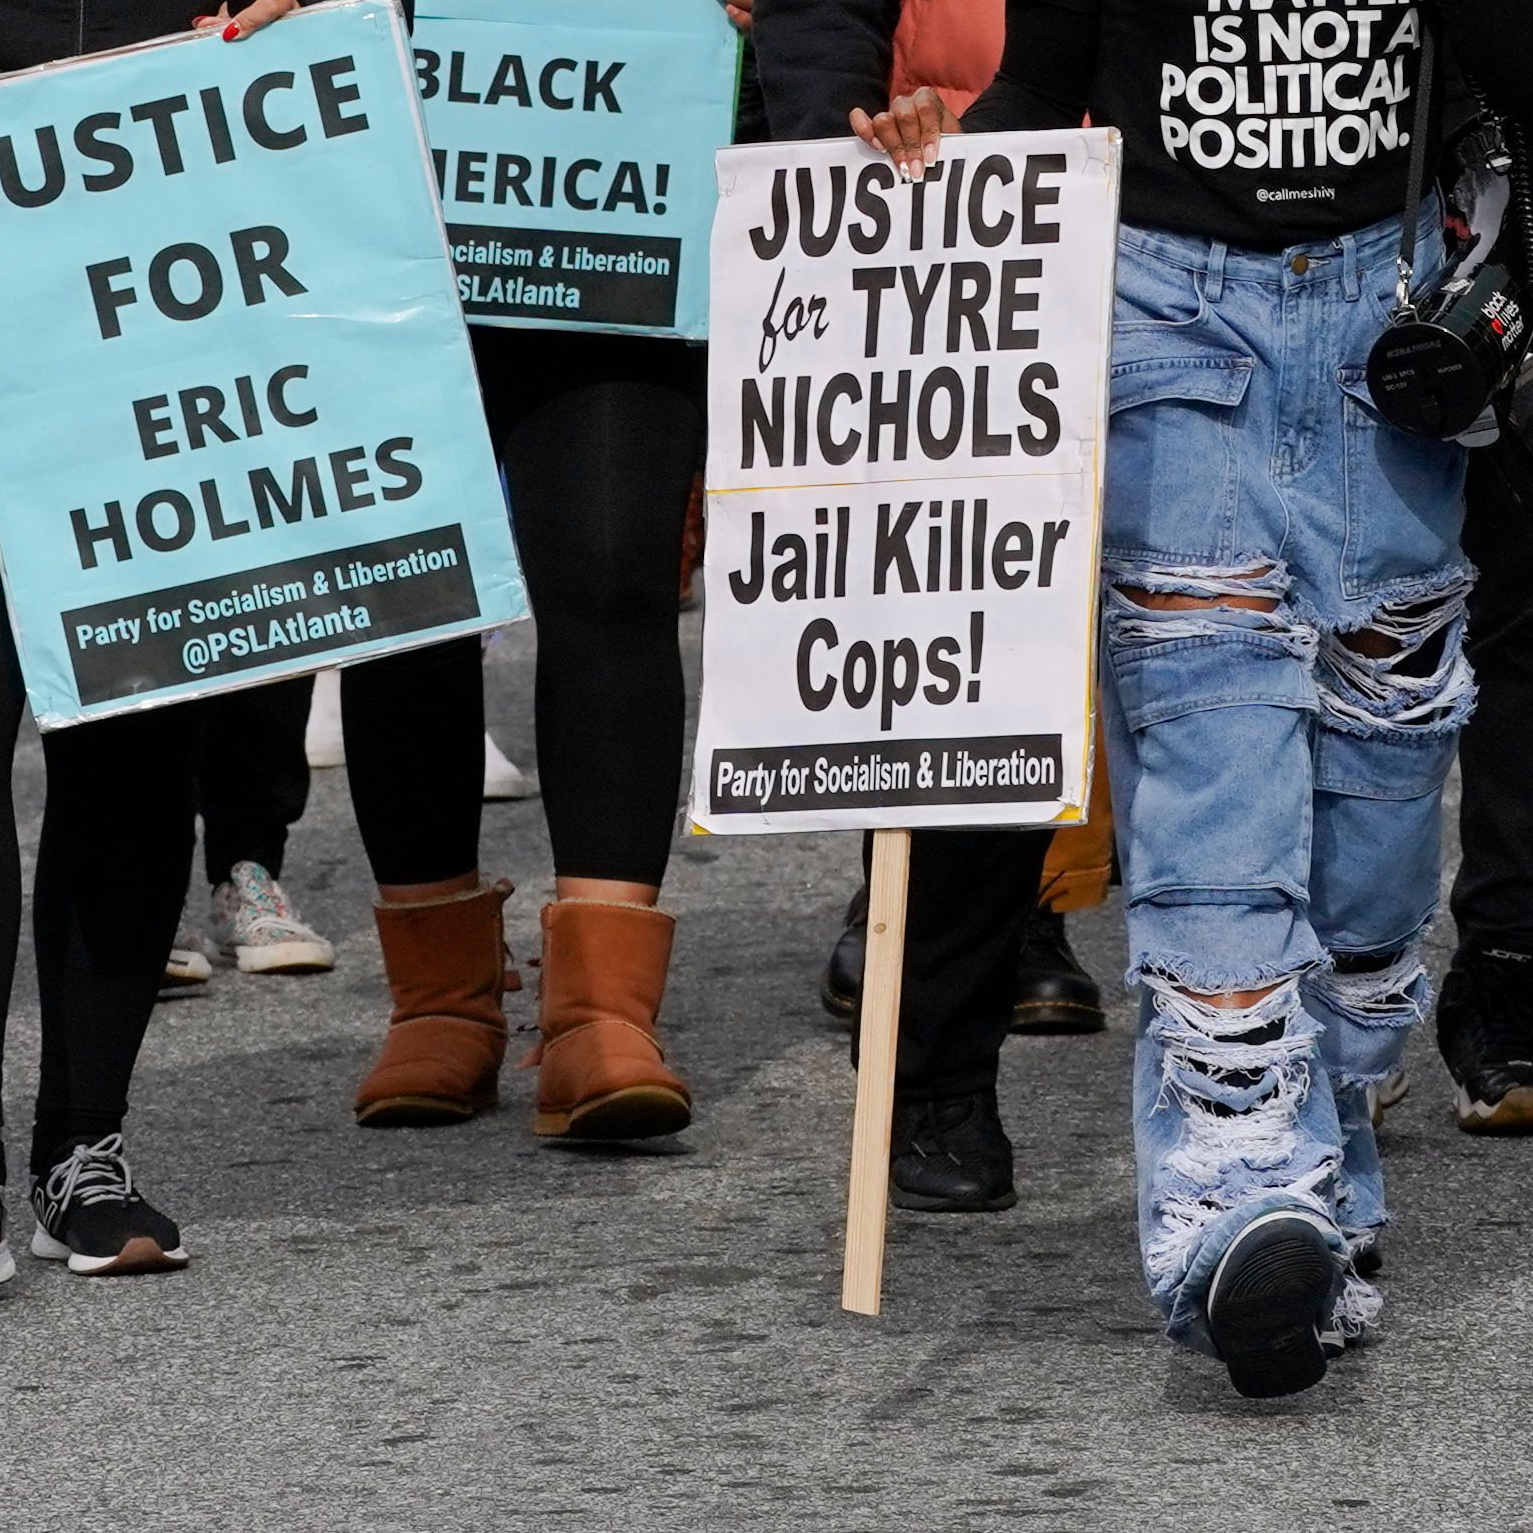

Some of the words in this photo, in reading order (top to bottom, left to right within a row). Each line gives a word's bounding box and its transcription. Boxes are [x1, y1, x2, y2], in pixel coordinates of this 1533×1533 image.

[413, 48, 627, 115] BLACK
[1193, 14, 1247, 64] IS
[1258, 9, 1382, 63] NOT
[1383, 7, 1421, 54] A
[1159, 54, 1411, 117] POLITICAL
[1159, 105, 1411, 170] POSITION.
[748, 153, 1068, 262] JUSTICE
[86, 224, 309, 342] FOR
[538, 244, 556, 270] &
[561, 245, 671, 277] Liberation
[1480, 290, 1508, 320] black
[759, 266, 831, 375] for
[851, 258, 1044, 359] TYRE
[132, 363, 319, 462] ERIC
[740, 361, 1062, 470] NICHOLS
[68, 435, 425, 572] HOLMES
[728, 505, 851, 606] Jail
[872, 498, 1071, 597] Killer
[75, 615, 143, 652] Party
[147, 603, 184, 635] for
[189, 581, 308, 628] Socialism
[313, 570, 332, 599] &
[335, 543, 460, 595] Liberation
[182, 604, 372, 677] @PSLAtlanta
[795, 610, 985, 732] Cops!
[716, 761, 778, 806] Party
[780, 761, 810, 797] for
[813, 754, 911, 794] Socialism
[917, 751, 935, 790] &
[940, 749, 1057, 790] Liberation
